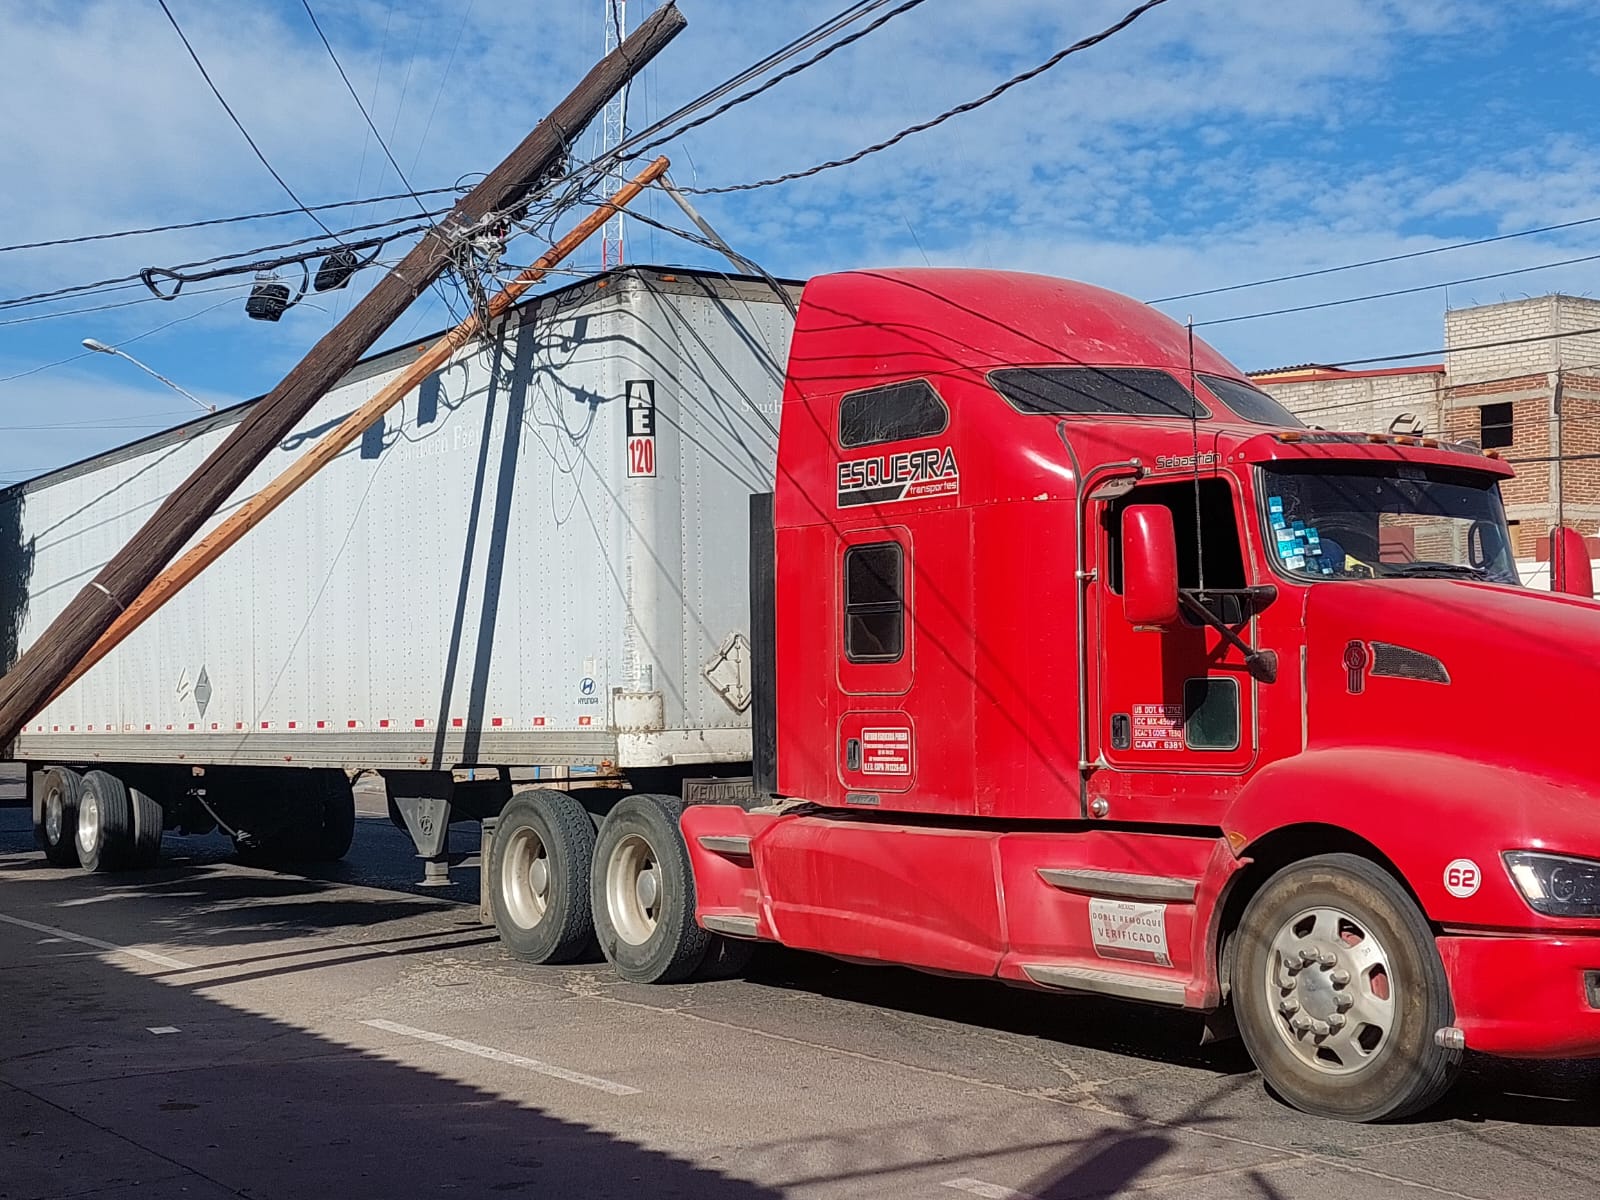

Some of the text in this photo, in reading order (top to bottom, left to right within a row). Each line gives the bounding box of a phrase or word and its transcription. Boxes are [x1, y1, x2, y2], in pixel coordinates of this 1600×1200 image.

[629, 438, 653, 474] 120
[838, 447, 958, 490] ESQUERRA
[909, 481, 957, 495] transportes
[1134, 717, 1146, 725] ICC
[1135, 740, 1182, 749] CAAT 6381
[1448, 868, 1475, 888] 62
[1092, 912, 1116, 922] DOBLE
[1097, 927, 1161, 945] VERIFICADO
